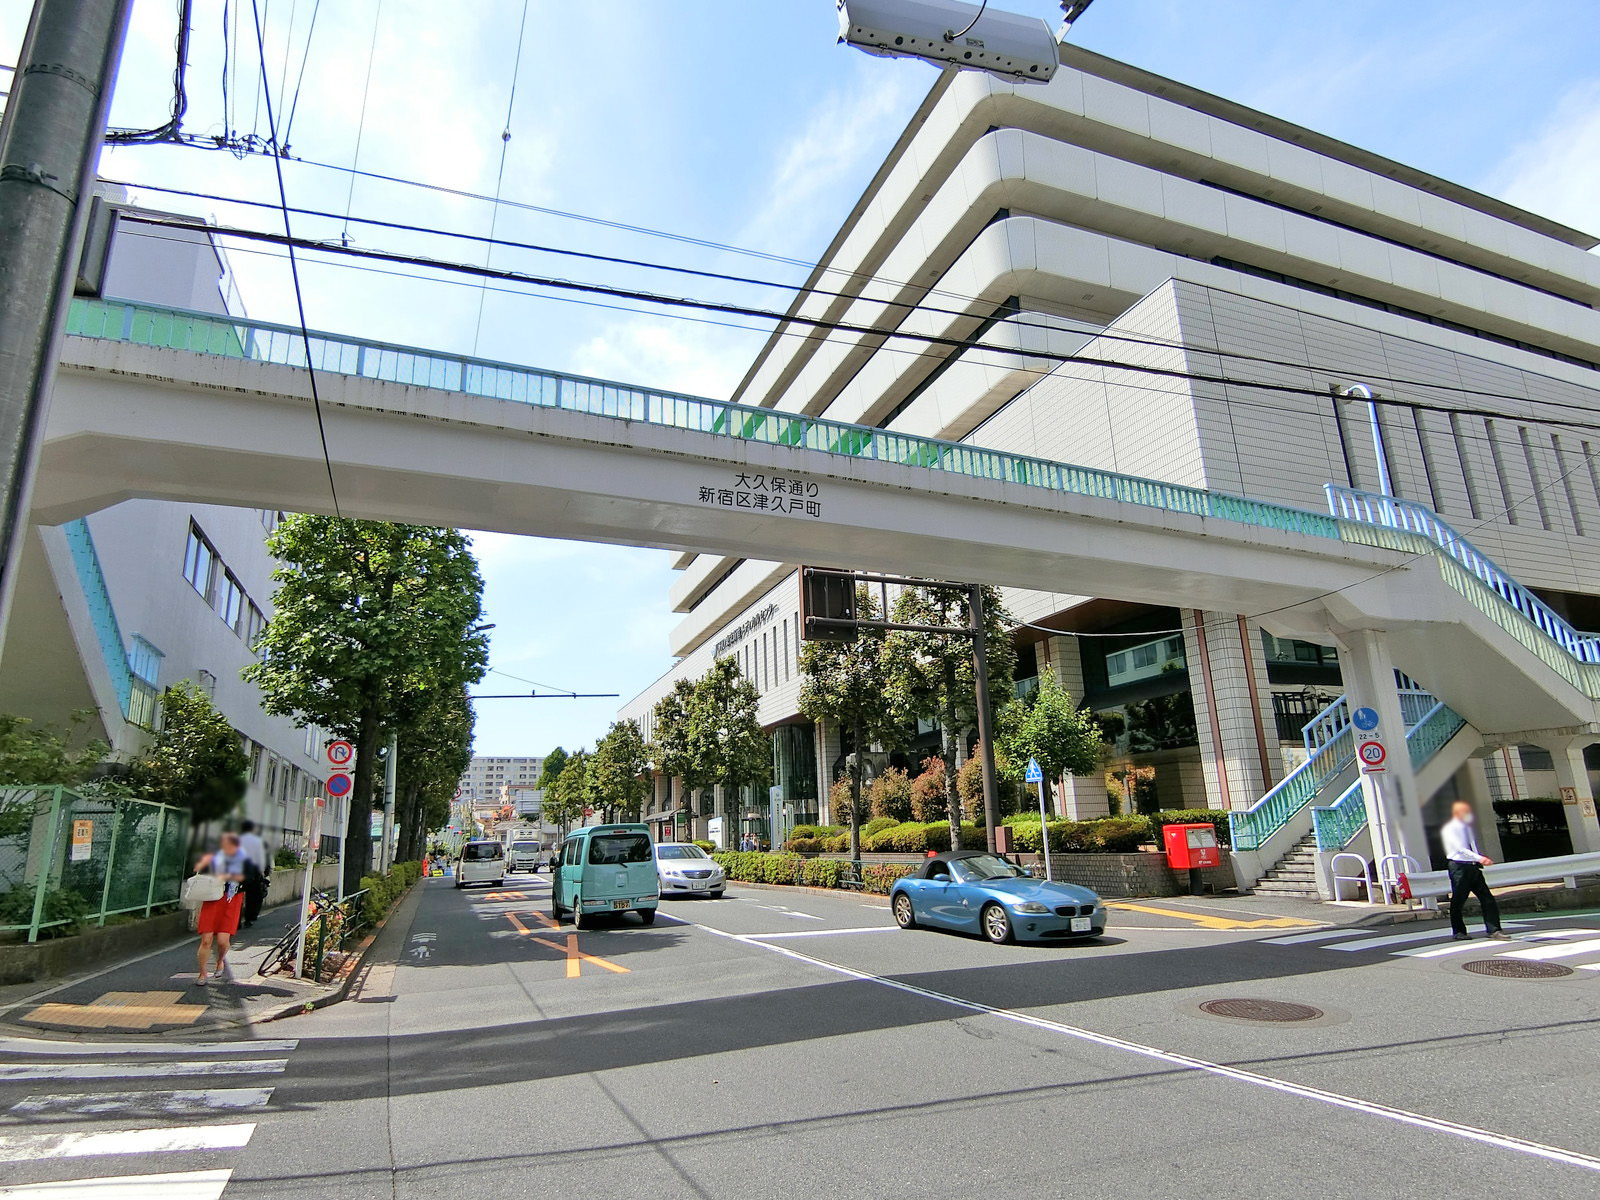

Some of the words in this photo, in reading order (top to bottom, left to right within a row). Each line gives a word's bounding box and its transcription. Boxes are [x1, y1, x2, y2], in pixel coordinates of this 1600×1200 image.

[734, 472, 819, 498] 大久保通り
[698, 486, 822, 518] 新宿区津久戸町
[1364, 747, 1381, 760] 20
